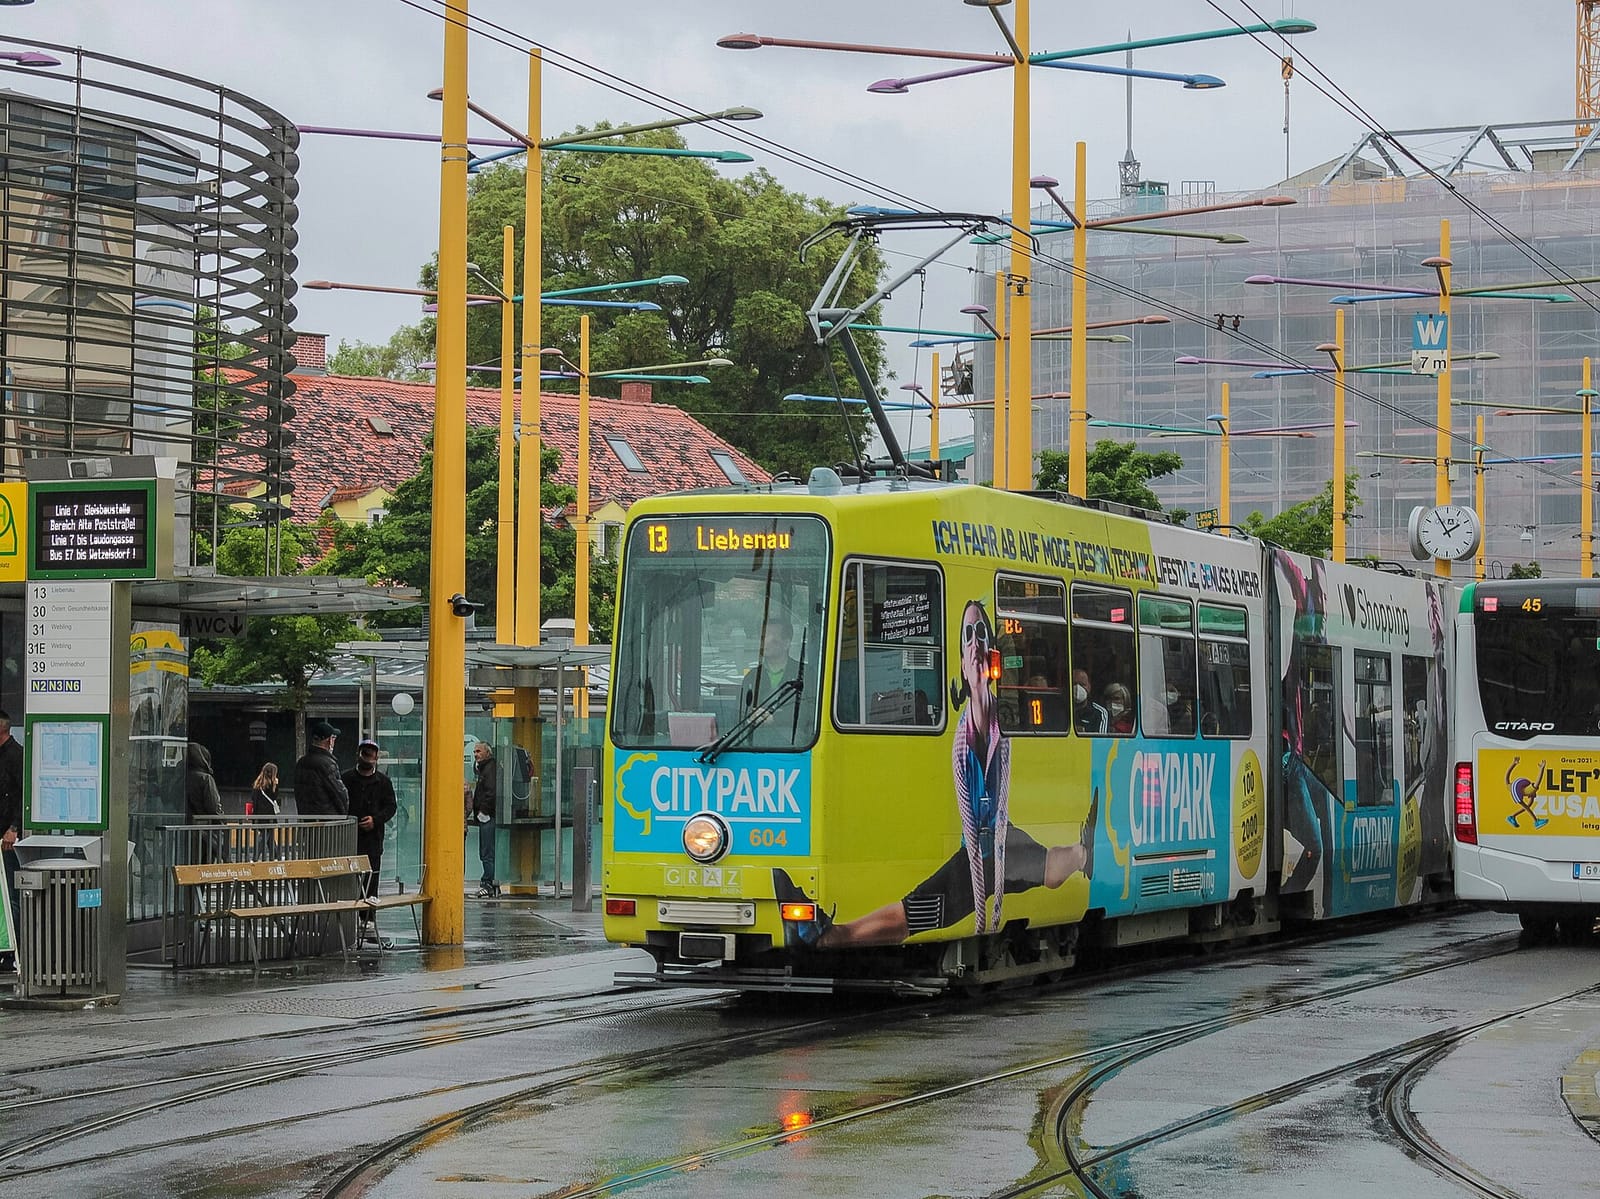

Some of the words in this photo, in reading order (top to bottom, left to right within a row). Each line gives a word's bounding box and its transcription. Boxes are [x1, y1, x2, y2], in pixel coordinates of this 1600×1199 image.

[1416, 320, 1445, 346] W
[1420, 356, 1429, 369] 7
[1433, 359, 1447, 369] m
[55, 504, 71, 517] Linie
[73, 504, 79, 516] 7
[50, 519, 76, 531] Bereich
[51, 534, 67, 546] Linie
[69, 534, 75, 545] 7
[76, 534, 88, 546] bis
[90, 533, 134, 546] Laudongasse
[648, 525, 668, 553] 13
[696, 526, 791, 550] Liebenau
[49, 549, 62, 561] Bus
[65, 549, 74, 560] E7
[76, 548, 87, 560] bis
[932, 520, 961, 555] ICH
[962, 522, 1000, 558] FAHR
[1000, 527, 1017, 560] AB
[1018, 530, 1039, 564] AUF
[1231, 568, 1240, 596] &
[1237, 569, 1262, 599] MEHR
[33, 587, 47, 599] 13
[32, 605, 46, 618] 30
[1521, 598, 1542, 612] 45
[1357, 587, 1410, 648] Shopping
[32, 624, 45, 636] 31
[195, 616, 226, 634] WC
[28, 642, 46, 655] 31E
[32, 661, 46, 673] 39
[32, 681, 47, 692] N2
[49, 681, 63, 692] N3
[65, 681, 80, 692] N6
[1495, 721, 1555, 731] CITARO
[650, 766, 801, 813] CITYPARK
[1242, 770, 1255, 797] 100
[1130, 750, 1216, 847] CITYPARK
[1241, 812, 1258, 843] 2000
[749, 828, 788, 847] 604
[1352, 816, 1394, 873] CITYPARK
[665, 868, 741, 887] GRAZ
